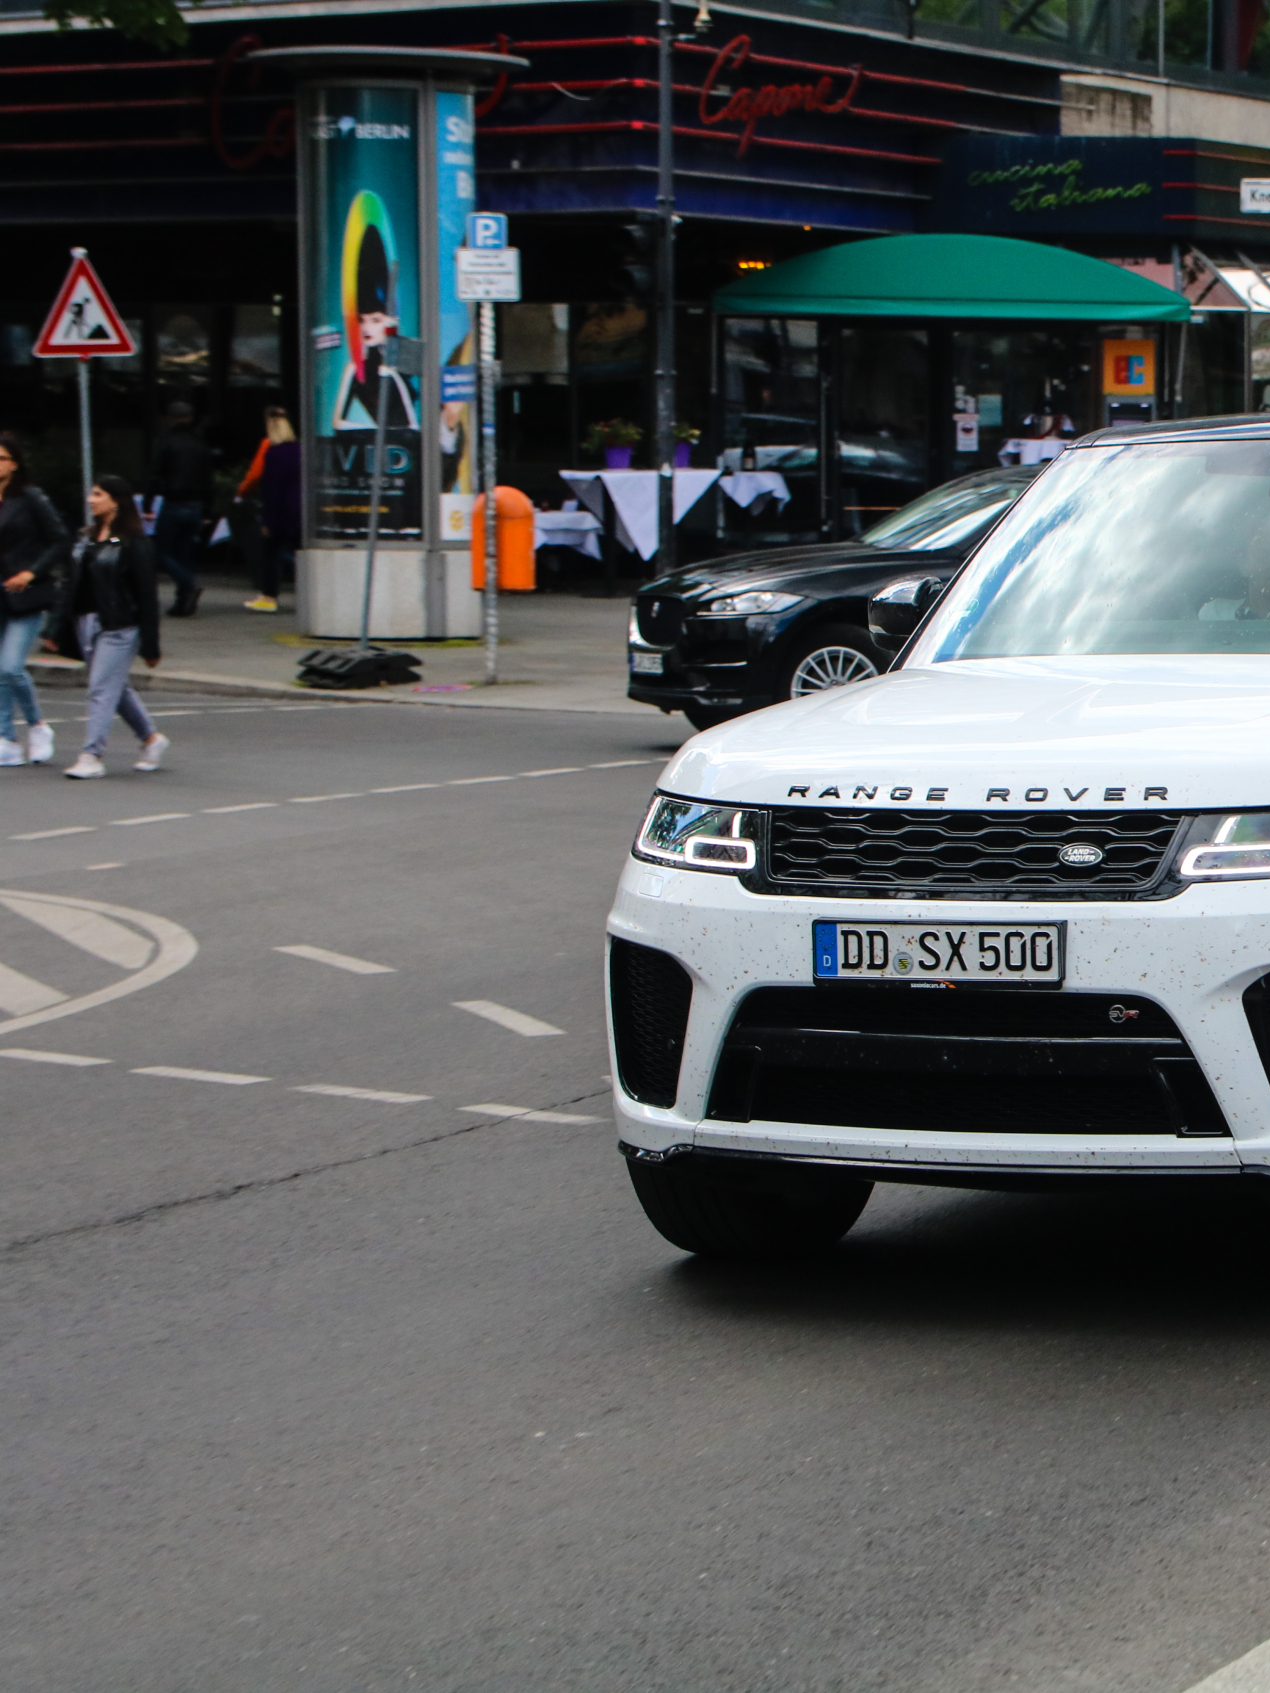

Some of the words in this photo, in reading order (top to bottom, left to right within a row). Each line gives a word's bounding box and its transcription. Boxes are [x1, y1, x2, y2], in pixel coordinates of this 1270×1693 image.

[699, 33, 863, 159] Capone
[355, 122, 411, 140] BERLIN
[475, 217, 499, 247] P
[1113, 355, 1145, 385] EC
[787, 784, 950, 801] RANGE
[985, 786, 1169, 802] ROVER
[822, 955, 832, 967] D
[840, 929, 889, 970] DD
[918, 930, 968, 972] SX
[978, 931, 1054, 972] 500
